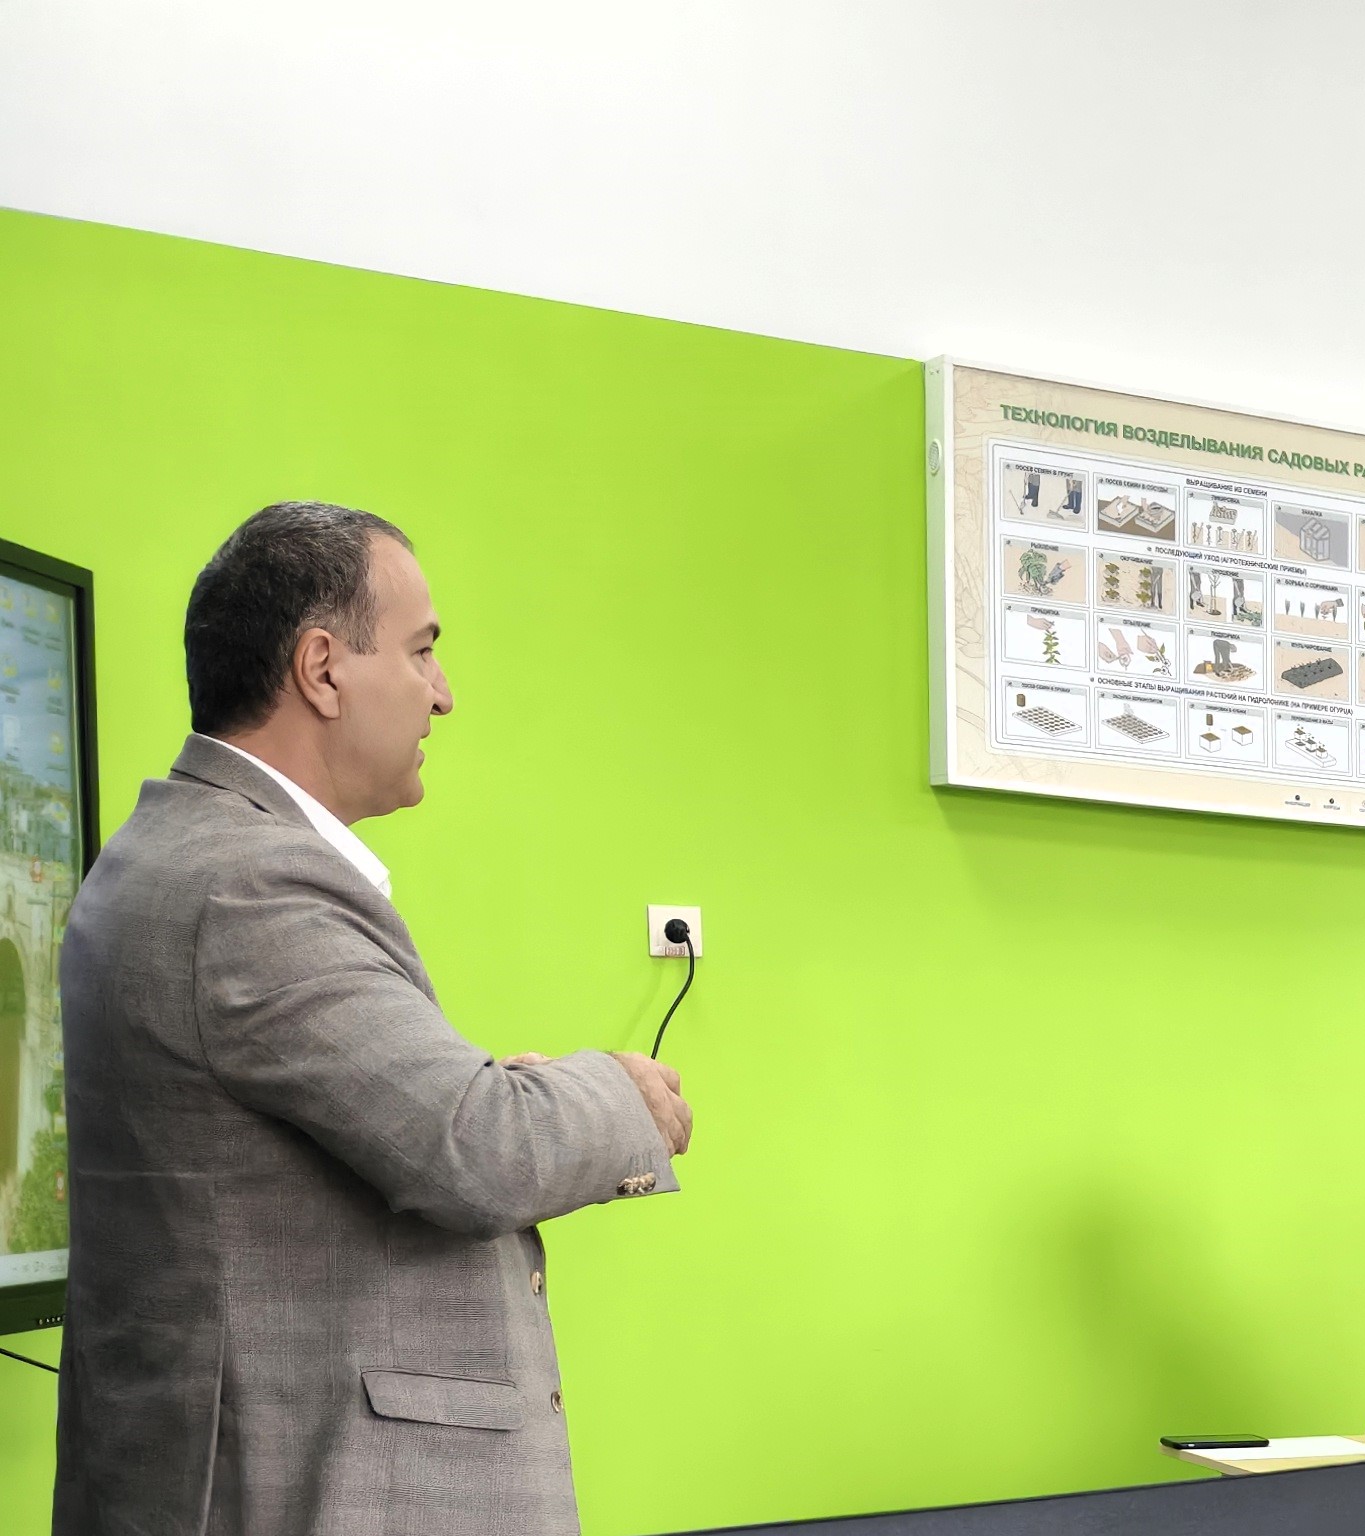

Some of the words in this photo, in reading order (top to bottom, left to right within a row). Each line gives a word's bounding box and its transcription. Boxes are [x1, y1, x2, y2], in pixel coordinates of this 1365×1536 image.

[1000, 404, 1118, 438] ТЕХНОЛОГИЯ
[1122, 424, 1264, 462] ВОЗДЕЛЫВАНИЯ
[1267, 448, 1349, 476] САДОВЫХ
